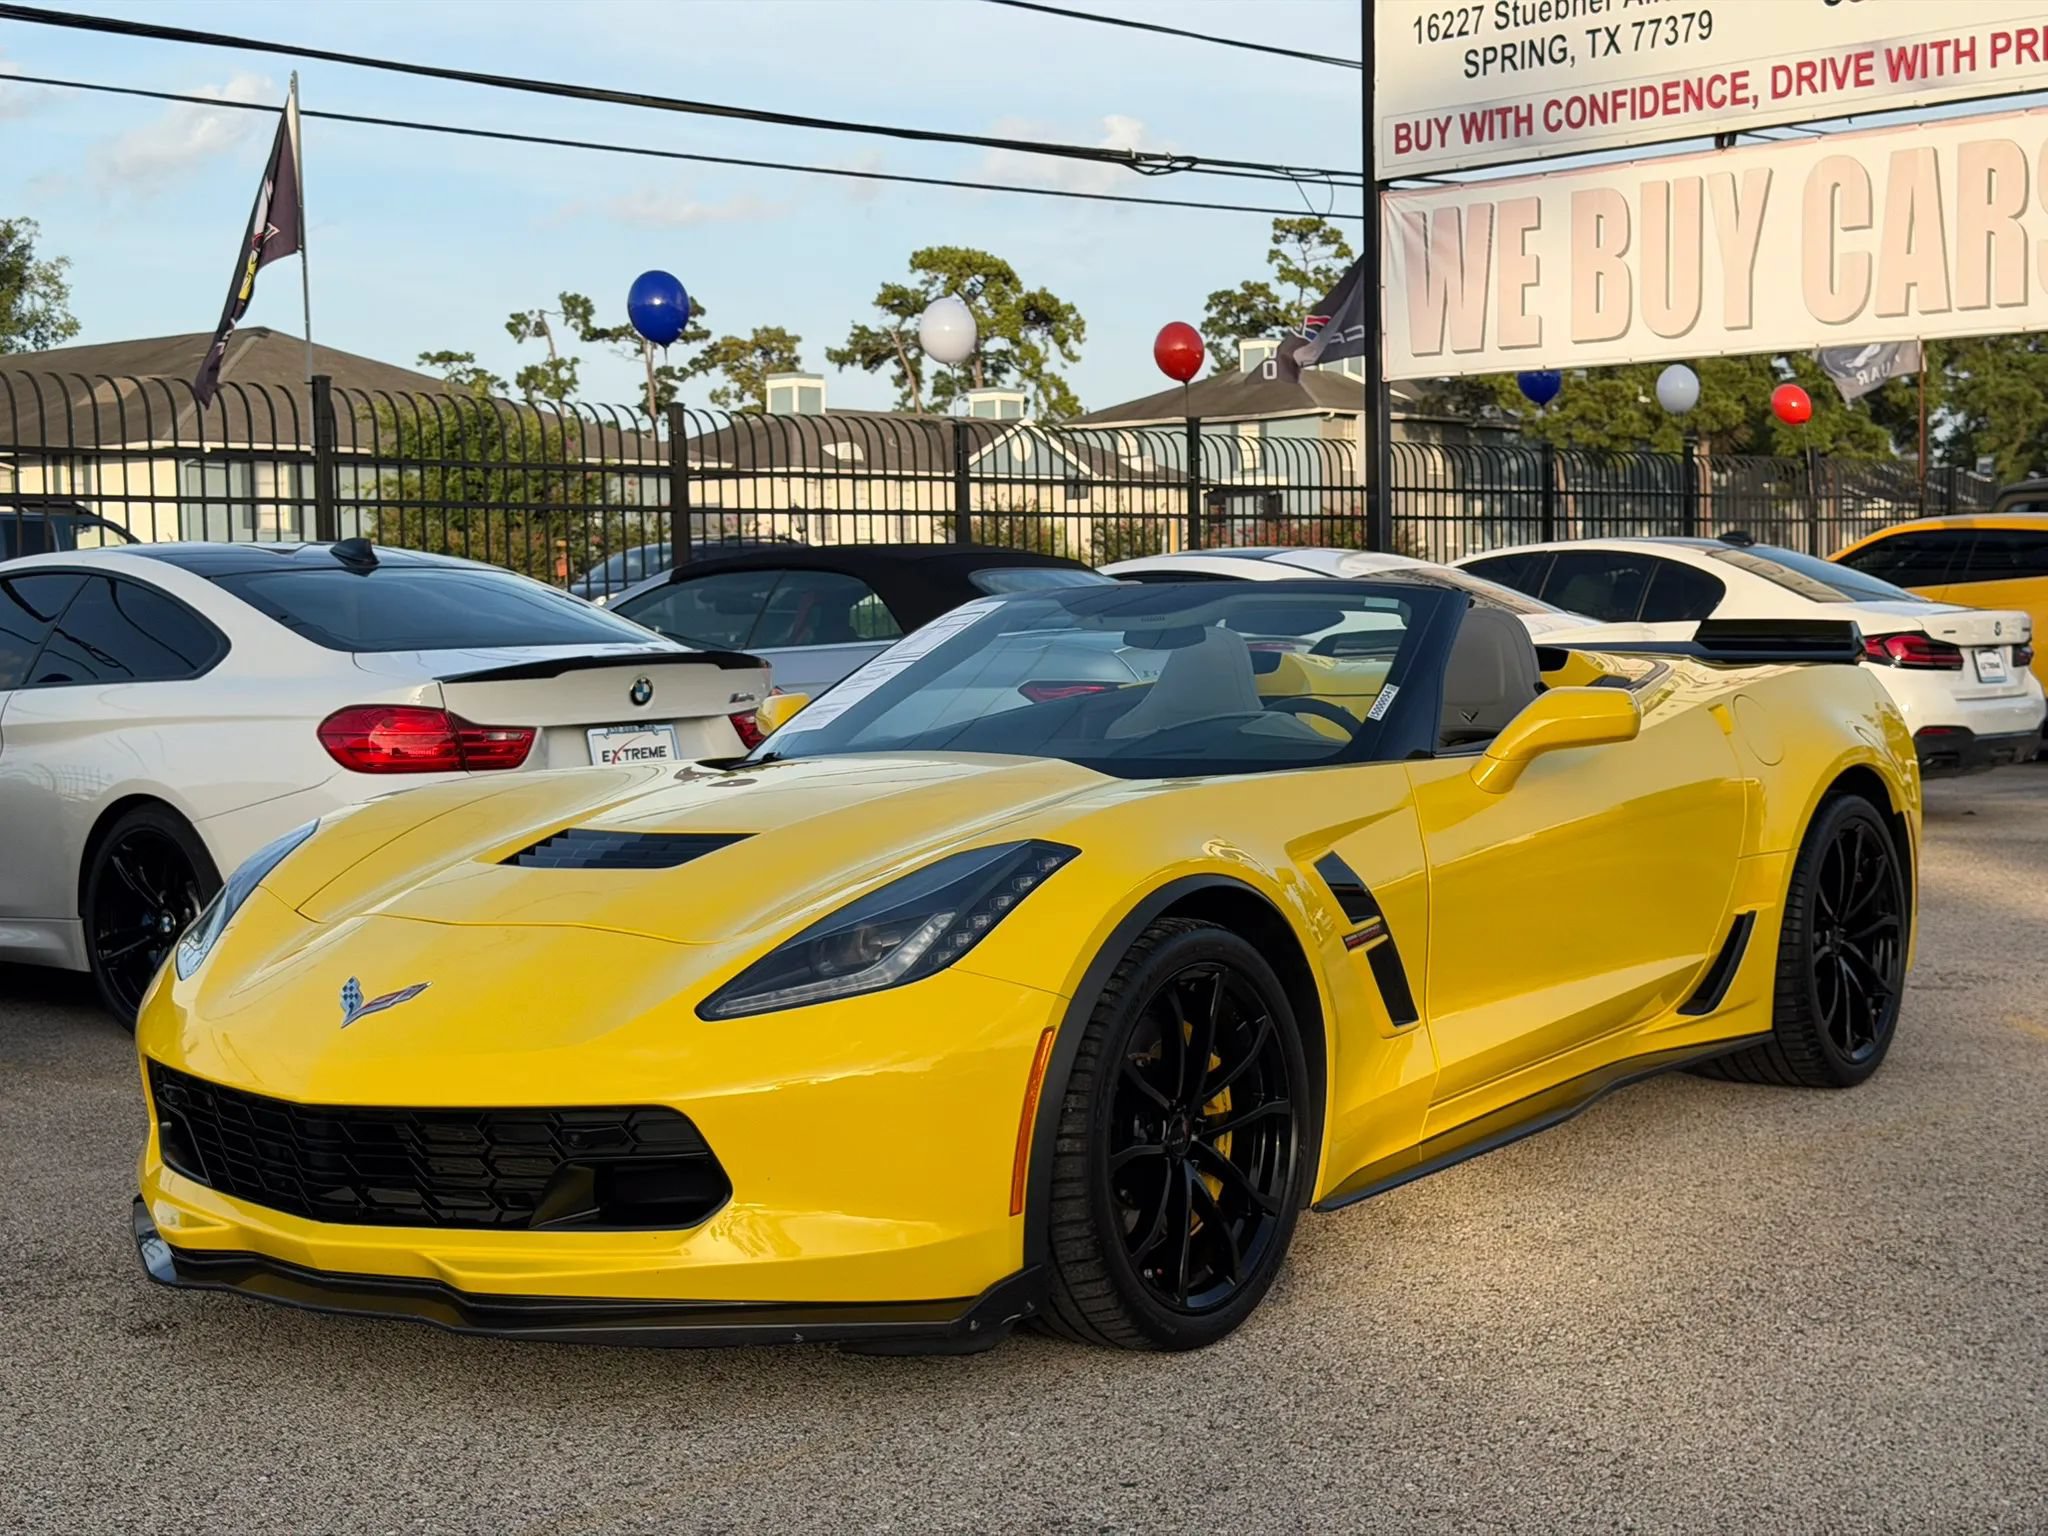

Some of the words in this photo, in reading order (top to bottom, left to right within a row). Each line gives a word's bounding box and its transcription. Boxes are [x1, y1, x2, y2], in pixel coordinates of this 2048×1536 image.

[1413, 5, 1485, 44] 16227
[1463, 34, 1577, 79] SPRING,
[1585, 24, 1622, 59] TX
[1631, 9, 1714, 52] 77379
[1393, 115, 1453, 155] BUY
[1459, 103, 1534, 145] WITH
[1542, 70, 1759, 133] CONFIDENCE,
[1771, 51, 1875, 99] DRIVE
[1885, 36, 1977, 83] WITH
[1401, 196, 1542, 358] WE
[1571, 167, 1774, 345] BUY
[1801, 137, 2048, 326] CAR
[601, 745, 667, 764] EXTREME
